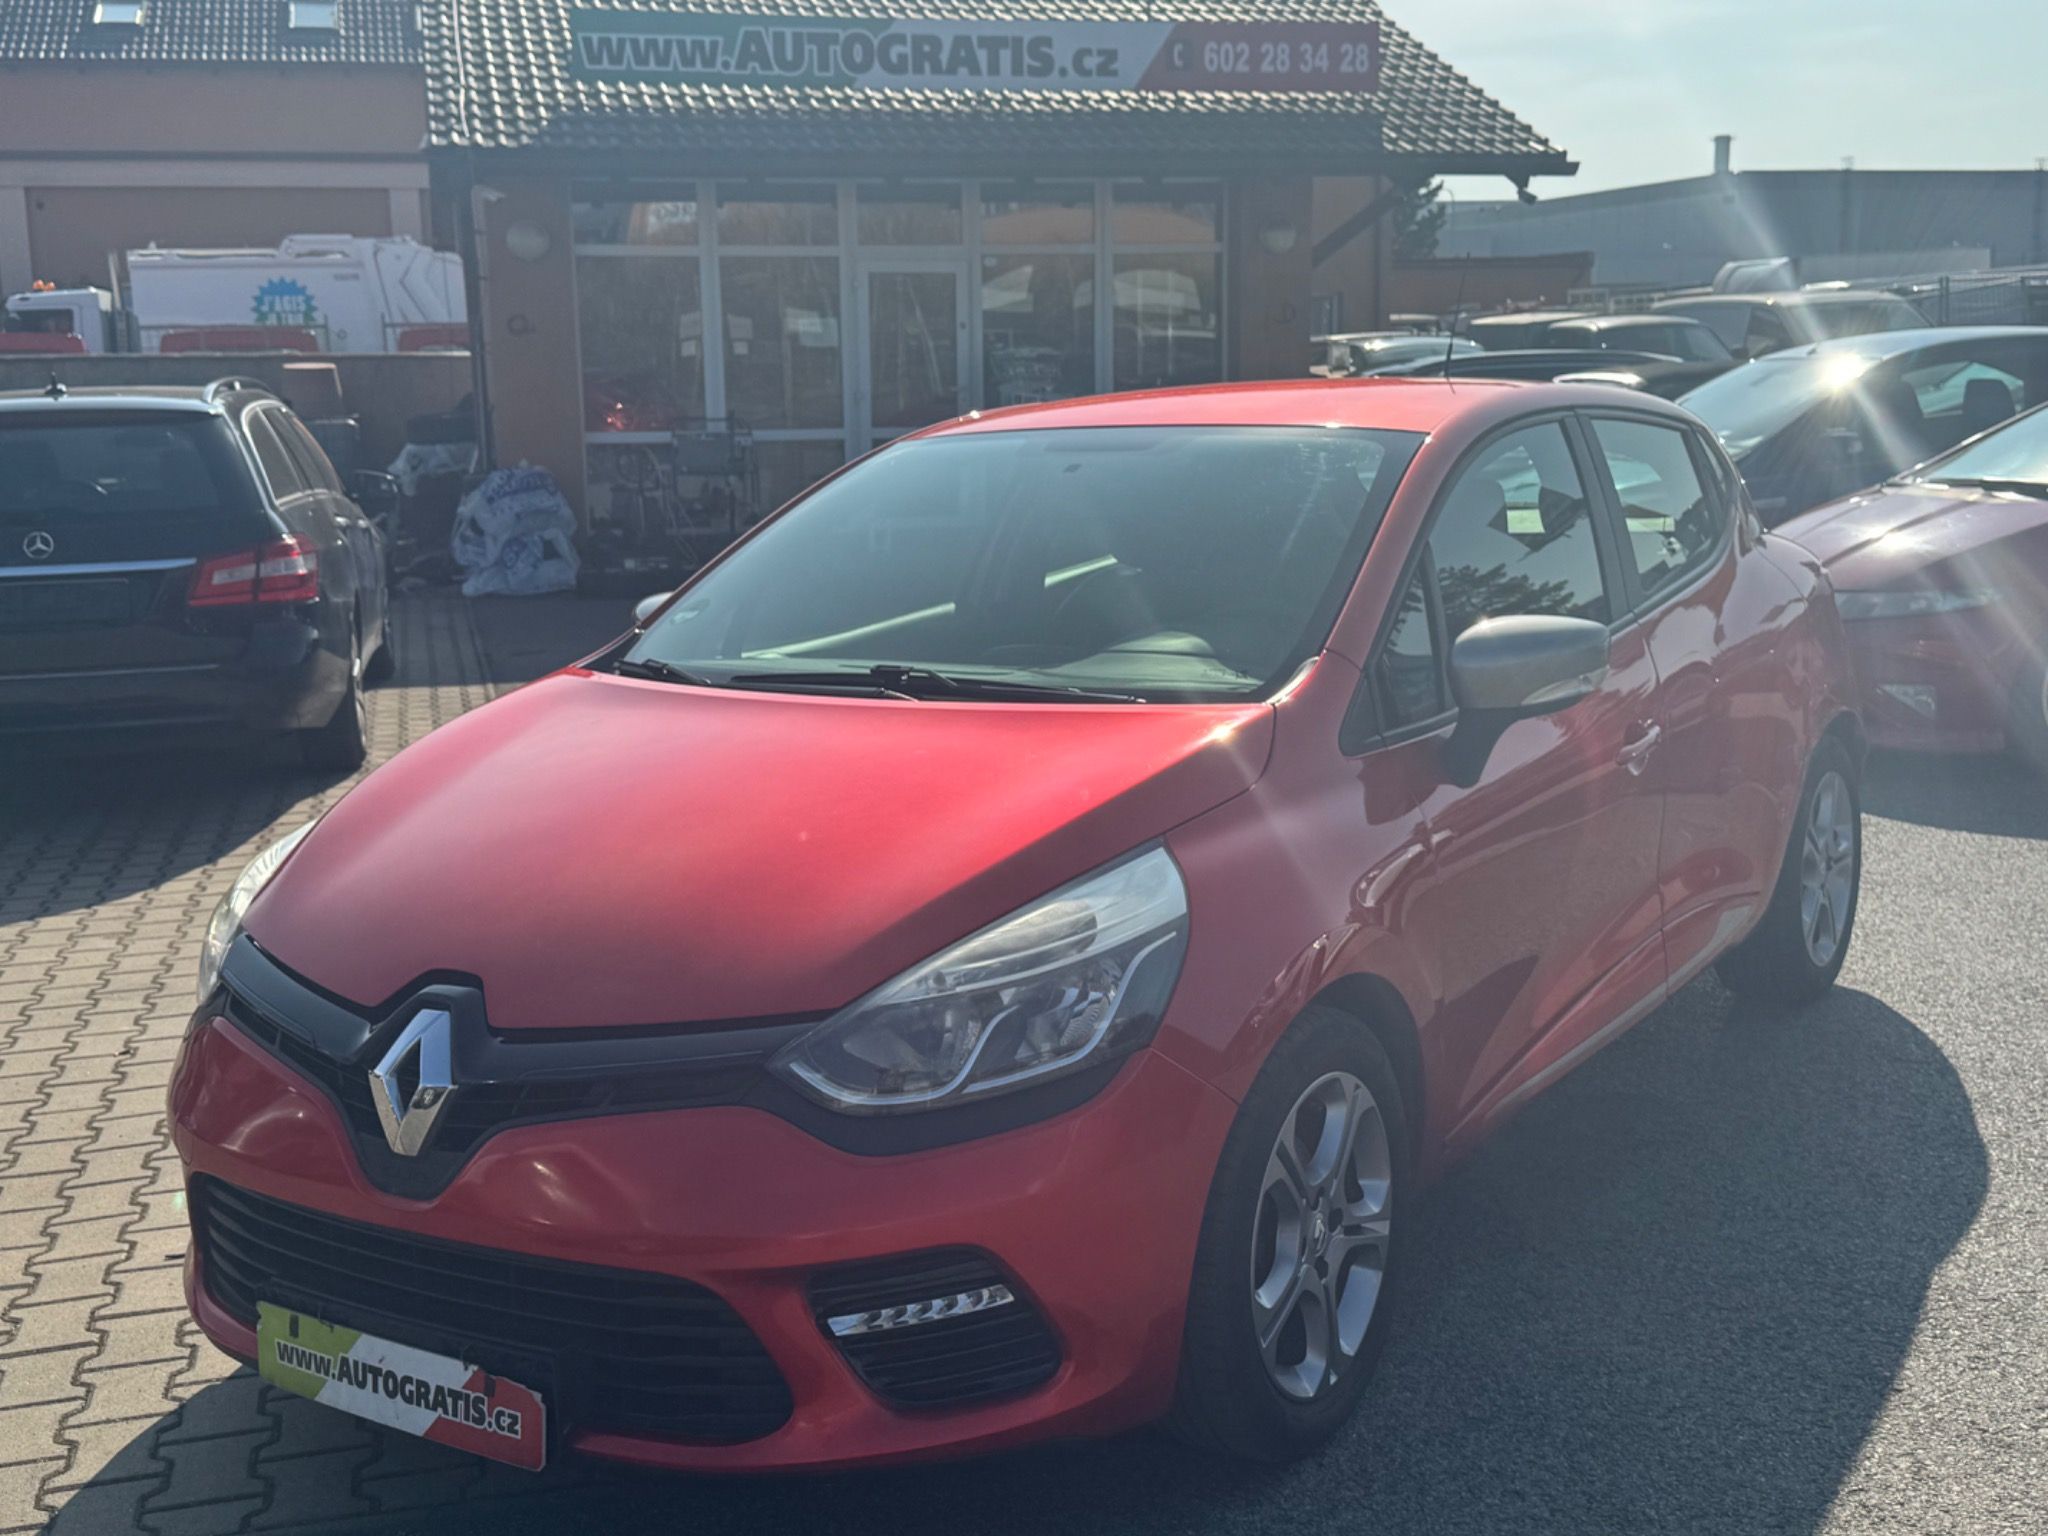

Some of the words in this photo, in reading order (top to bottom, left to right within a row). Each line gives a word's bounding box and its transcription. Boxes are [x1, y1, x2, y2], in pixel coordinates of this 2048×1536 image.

[578, 26, 1119, 79] www.AUTOGRATIS.cz
[1203, 41, 1250, 73] 602
[1260, 42, 1290, 73] 28
[1300, 43, 1329, 73] 34
[1340, 43, 1369, 73] 28
